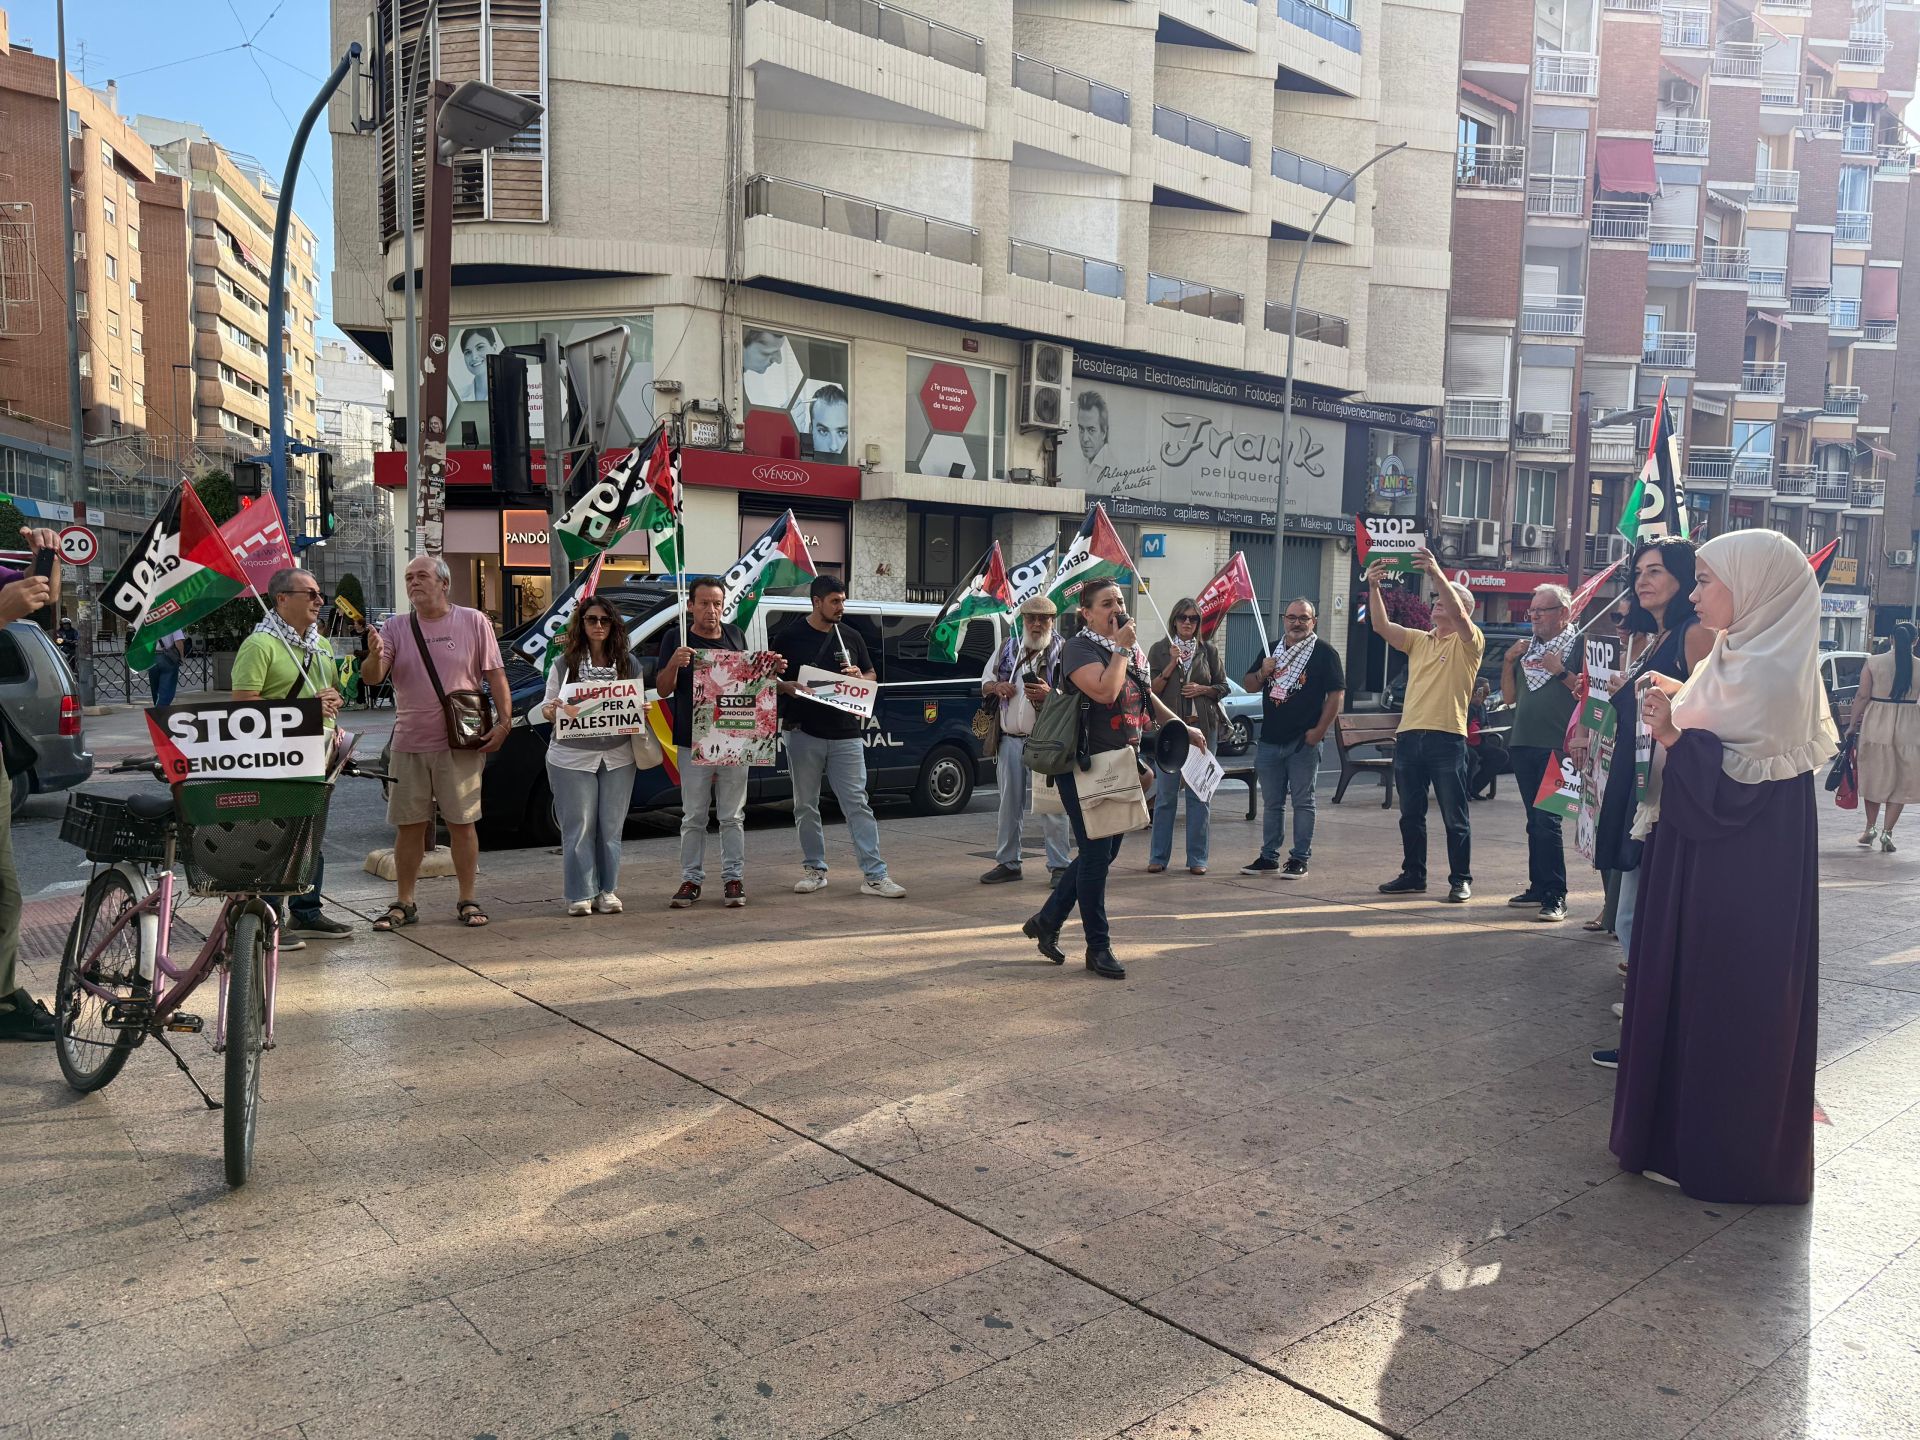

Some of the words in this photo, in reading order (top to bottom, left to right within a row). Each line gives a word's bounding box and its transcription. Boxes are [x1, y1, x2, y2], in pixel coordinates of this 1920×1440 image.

[941, 385, 968, 396] preocupa
[1073, 353, 1138, 381] Presoterapia
[1145, 367, 1237, 397] Electroestimulación
[1245, 384, 1307, 409] Fotodepilción
[1312, 397, 1397, 425] Fotorrejuvenecimiento
[1400, 412, 1437, 430] Cavitación
[942, 402, 949, 410] tu
[949, 404, 965, 412] pelo?
[758, 464, 804, 482] SVENSON
[1112, 500, 1167, 517] Tratamientos
[1173, 508, 1210, 522] capilares
[1300, 518, 1333, 533] Make-up
[1337, 519, 1356, 532] Uñas
[1366, 518, 1416, 534] STOP
[64, 538, 90, 552] 20
[1365, 539, 1416, 548] GENOCIDIO
[1471, 576, 1506, 587] vodafone
[1586, 640, 1614, 670] STOP
[574, 683, 638, 701] JUSTÍCIA
[832, 680, 870, 699] STOP
[602, 701, 624, 711] PER
[626, 699, 636, 709] A
[720, 696, 754, 707] STOP
[167, 706, 304, 744] STOP
[559, 712, 643, 731] PALESTINA
[173, 750, 304, 775] GENOCIDIO
